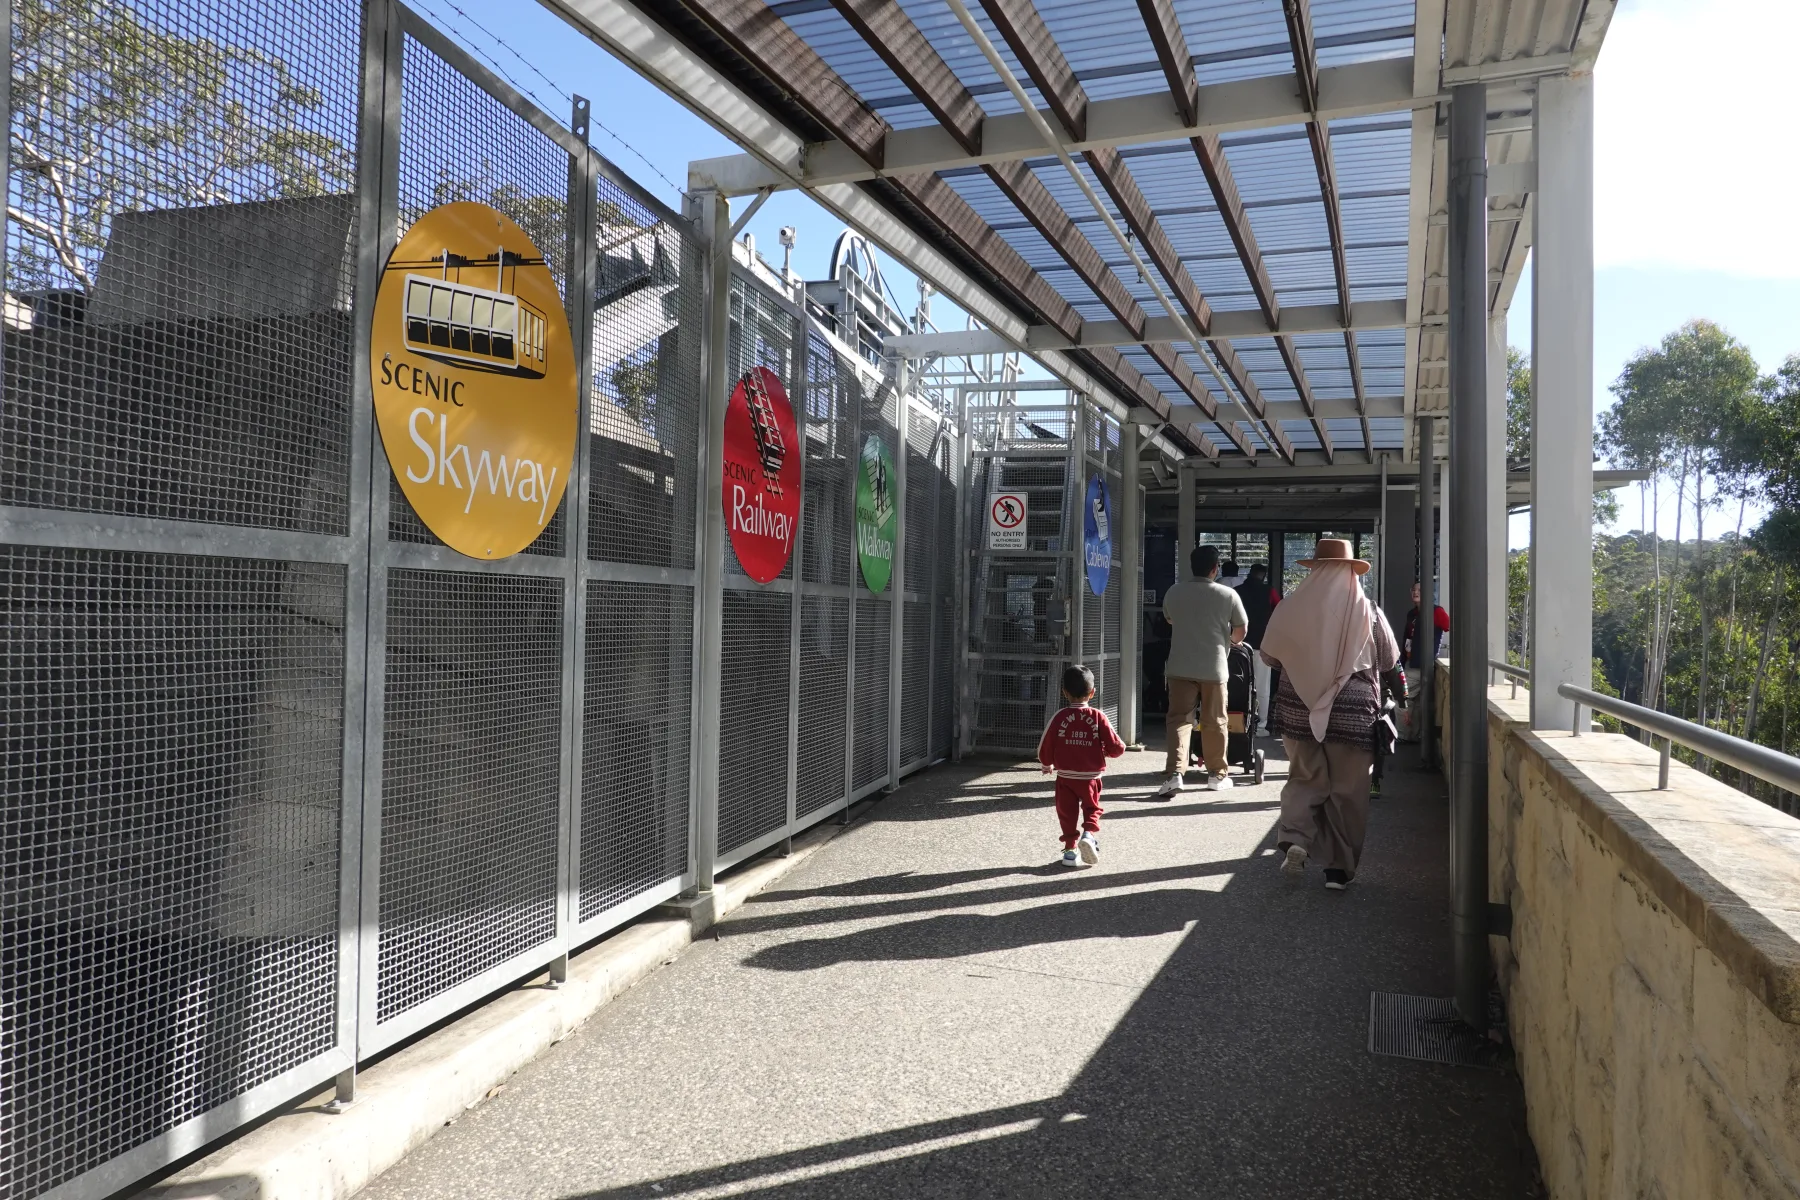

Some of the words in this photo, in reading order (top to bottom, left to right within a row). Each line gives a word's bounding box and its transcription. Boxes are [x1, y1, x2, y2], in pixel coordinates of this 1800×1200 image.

[381, 357, 465, 407] SCENIC
[406, 407, 557, 526] Skyway
[724, 459, 756, 484] SCENIC
[733, 484, 793, 554] Railway
[858, 521, 894, 570] Walkway
[1058, 713, 1076, 737] NEW
[1080, 713, 1099, 739] YORK
[1065, 739, 1093, 747] BROOKLYN
